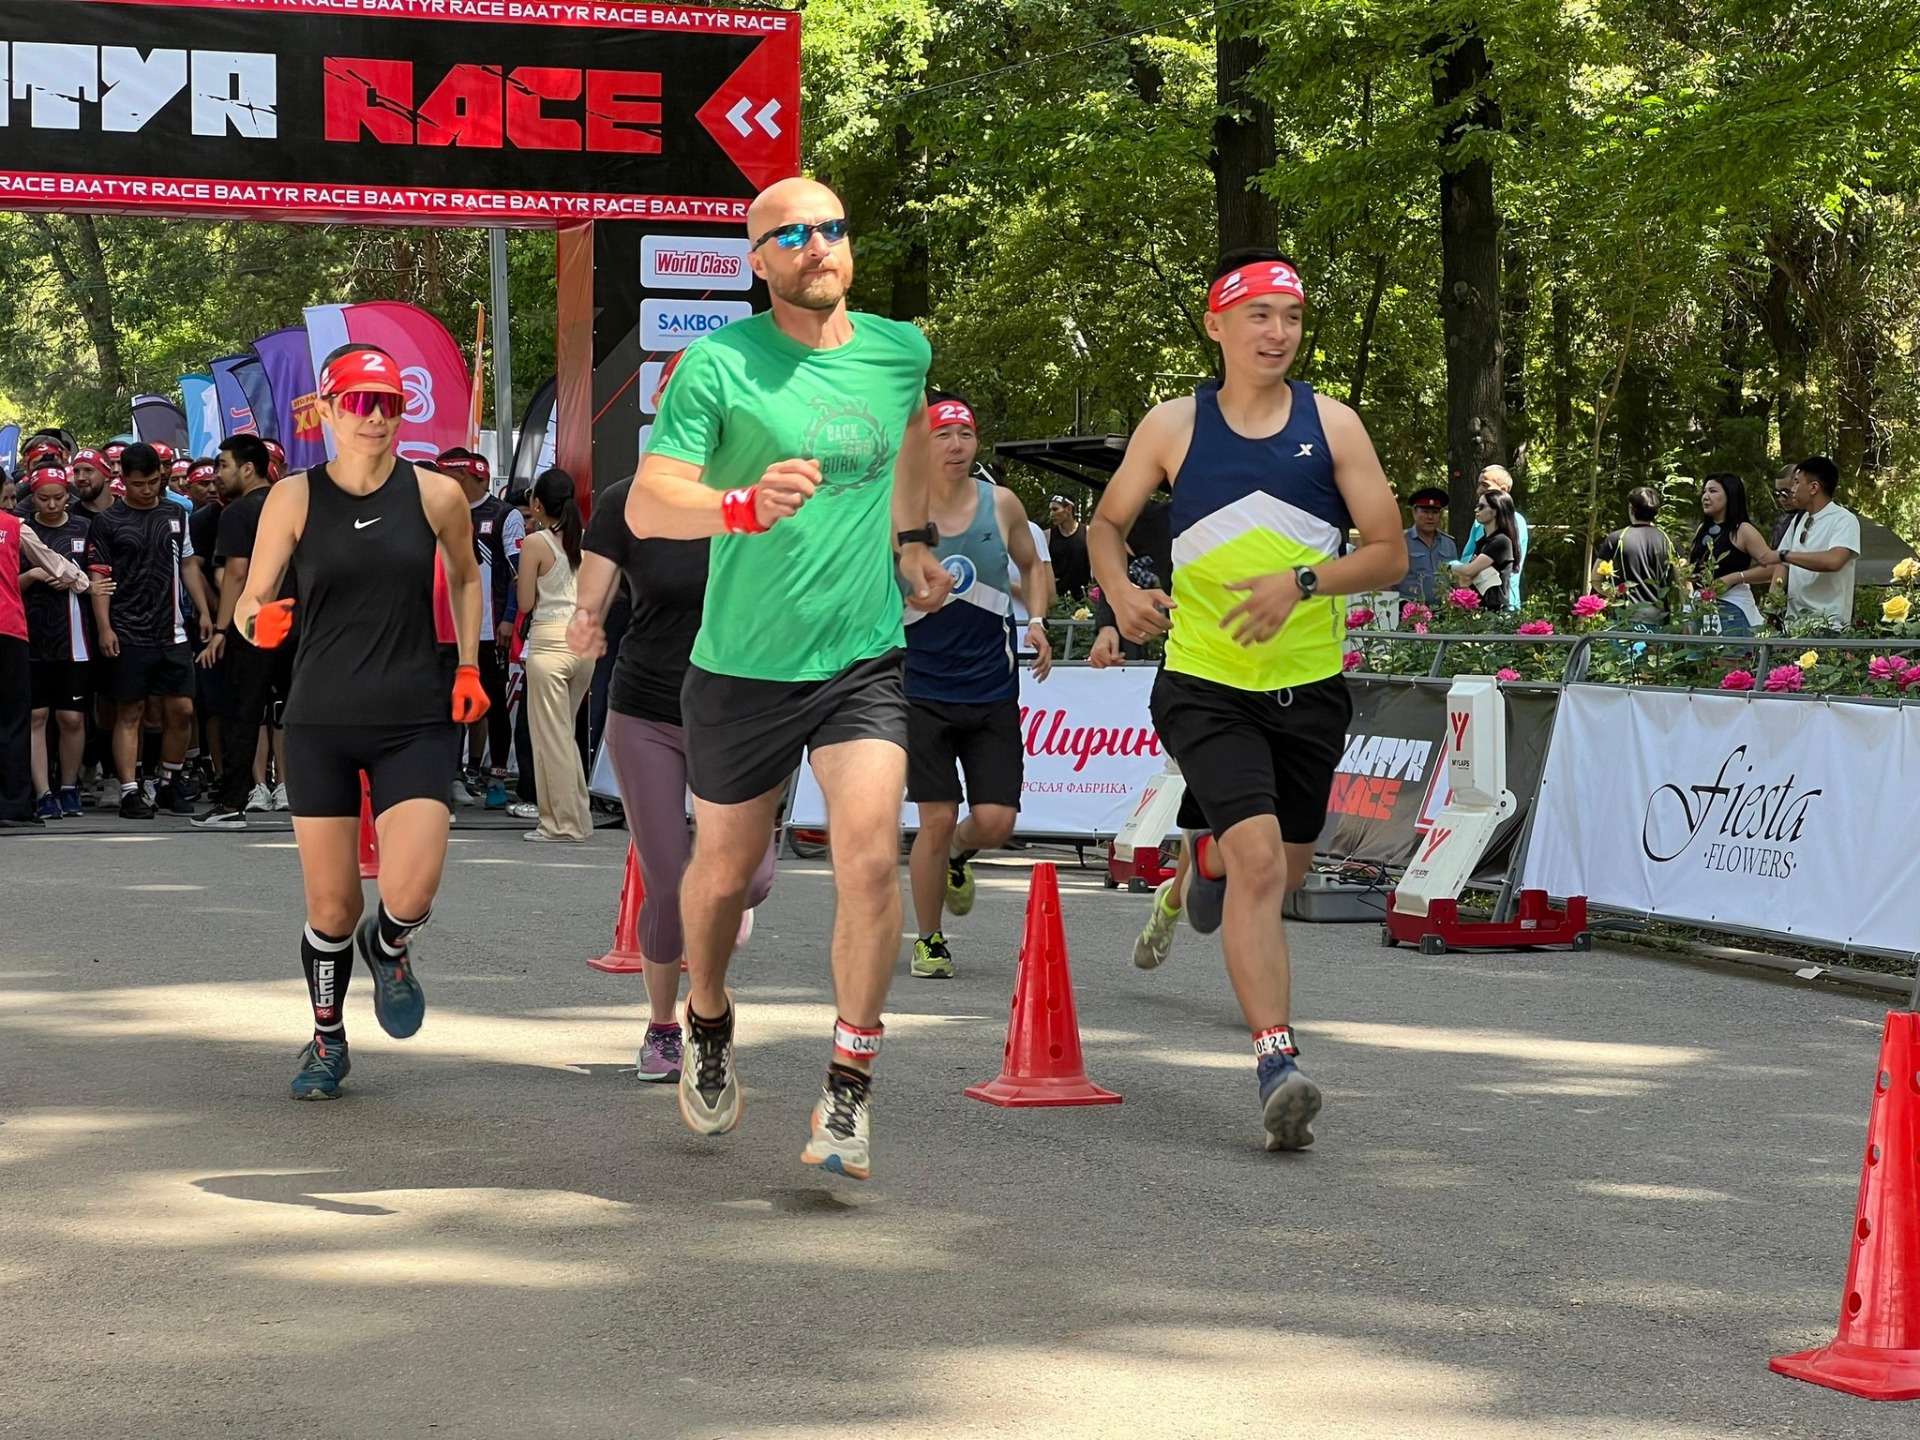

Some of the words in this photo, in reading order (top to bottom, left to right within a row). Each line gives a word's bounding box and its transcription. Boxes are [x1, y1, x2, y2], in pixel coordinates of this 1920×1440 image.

[450, 1, 505, 16] RACE
[509, 3, 590, 20] BAATYR
[594, 7, 647, 23] RACE
[651, 10, 730, 28] BAATYR
[734, 15, 787, 30] RACE
[0, 41, 278, 139] TYR
[323, 56, 662, 154] RACE
[0, 176, 55, 191] RACE
[60, 178, 147, 196] BAATYR
[152, 182, 210, 198] RACE
[214, 185, 299, 202] BAATYR
[303, 188, 360, 204] RACE
[364, 190, 447, 207] BAATYR
[451, 193, 506, 209] RACE
[510, 195, 589, 212] BAATYR
[593, 198, 646, 213] RACE
[650, 200, 728, 216] BAATYR
[657, 252, 699, 274] World
[700, 254, 740, 275] Class
[361, 353, 386, 372] 2
[938, 404, 970, 422] 22
[827, 423, 858, 441] BACK
[48, 468, 65, 480] 53
[196, 465, 214, 477] 30
[822, 456, 858, 474] BURN
[1333, 734, 1433, 782] AATYR
[1066, 782, 1128, 794] ФАБРИКА
[1326, 773, 1402, 821] RACE
